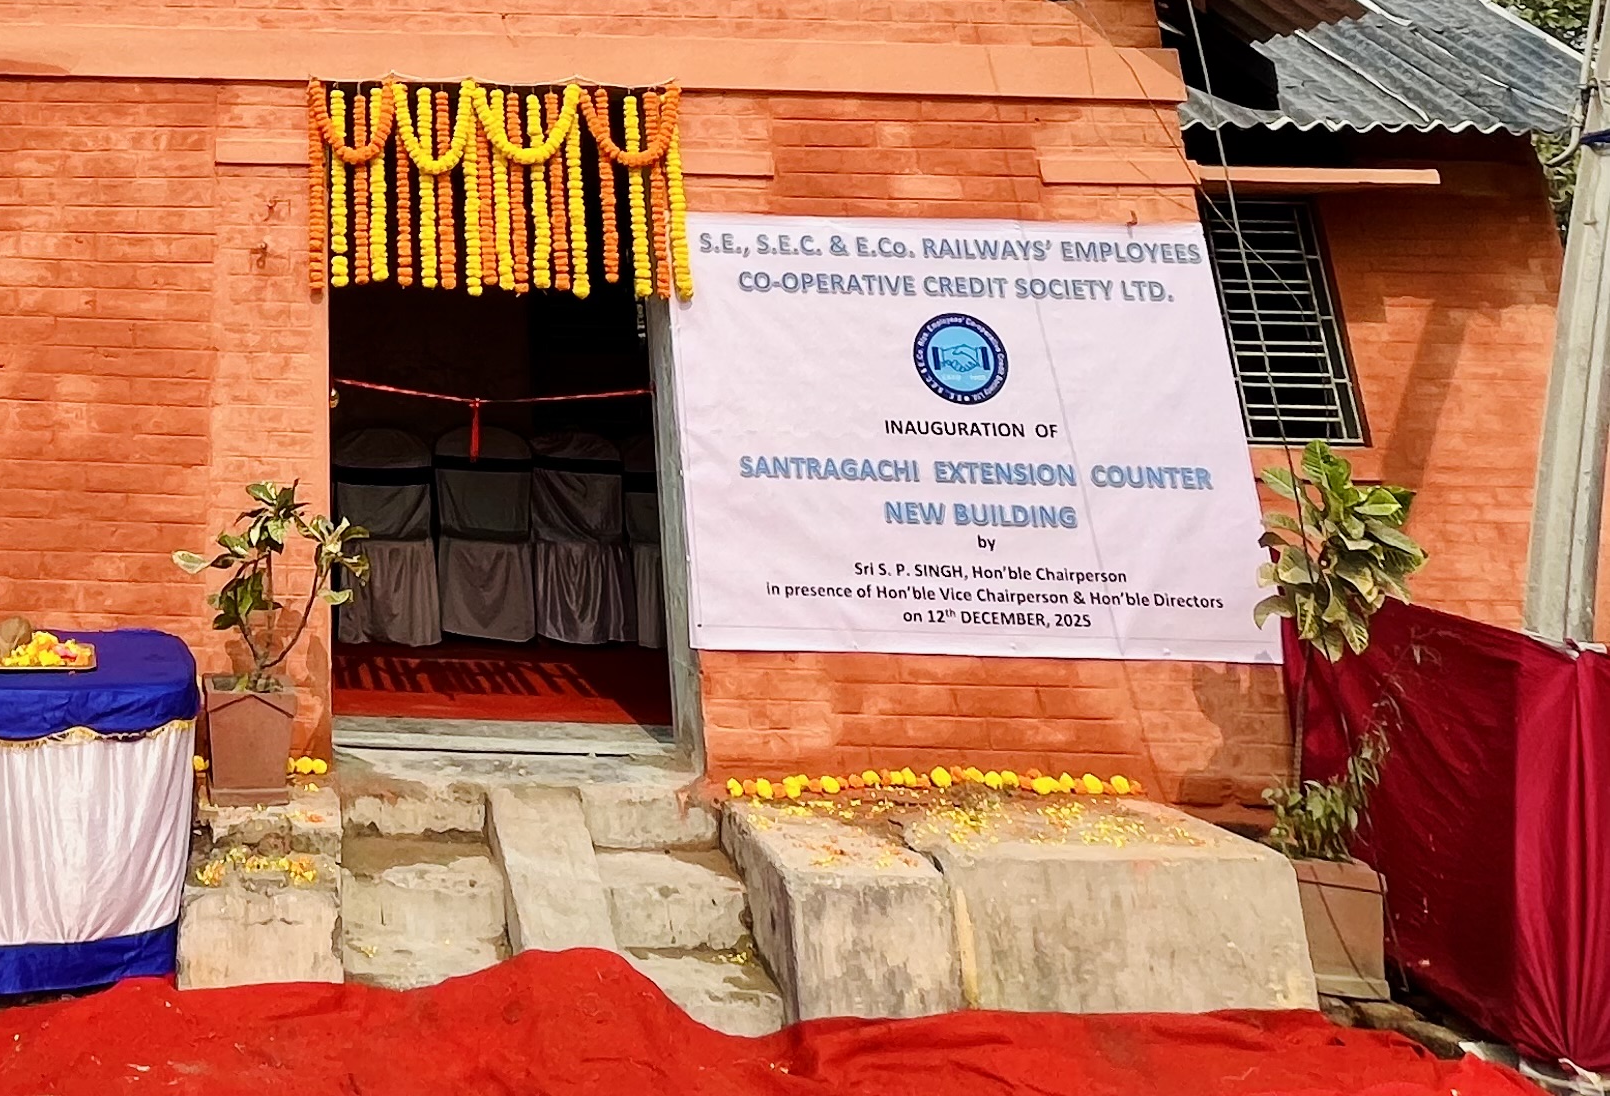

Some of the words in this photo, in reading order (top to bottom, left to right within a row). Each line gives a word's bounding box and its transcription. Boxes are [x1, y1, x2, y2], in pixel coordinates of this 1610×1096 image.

[699, 233, 749, 257] S.E.,
[756, 234, 822, 255] S.E.C.
[829, 235, 849, 256] &
[856, 236, 915, 258] E.Co.
[922, 237, 1052, 262] RAILWAYS'
[1060, 240, 1203, 264] EMPLOYEES
[738, 271, 917, 296] CO-OPERATIVE
[922, 275, 1009, 298] CREDIT
[1014, 278, 1114, 301] SOCIETY
[1120, 280, 1174, 302] LTD.
[884, 420, 1025, 437] INAUGURATION
[1035, 424, 1058, 438] OF
[739, 455, 920, 482] SANTRAGACHI
[933, 461, 1077, 486] EXTENSION
[1090, 465, 1214, 490] COUNTER
[884, 500, 946, 525] NEW
[954, 503, 1078, 528] BUILDING
[977, 534, 996, 551] by
[854, 562, 874, 576] Sri
[878, 563, 892, 577] S.
[896, 563, 911, 577] P.
[914, 564, 969, 580] SINGH,
[972, 565, 1032, 580] Hon'ble
[1036, 567, 1127, 584] Chairperson
[766, 582, 780, 596] in
[785, 584, 852, 599] presence
[856, 584, 872, 599] of
[876, 585, 936, 600] Hon'ble
[939, 587, 972, 601] Vice
[977, 588, 1068, 606] Chairperson
[1073, 590, 1086, 604] &
[1089, 591, 1150, 607] Hon'ble
[1153, 593, 1224, 609] Directors
[903, 611, 922, 623] on
[928, 608, 956, 623] 12th
[961, 611, 1050, 629] DECEMBER,
[1054, 613, 1092, 628] 2025
